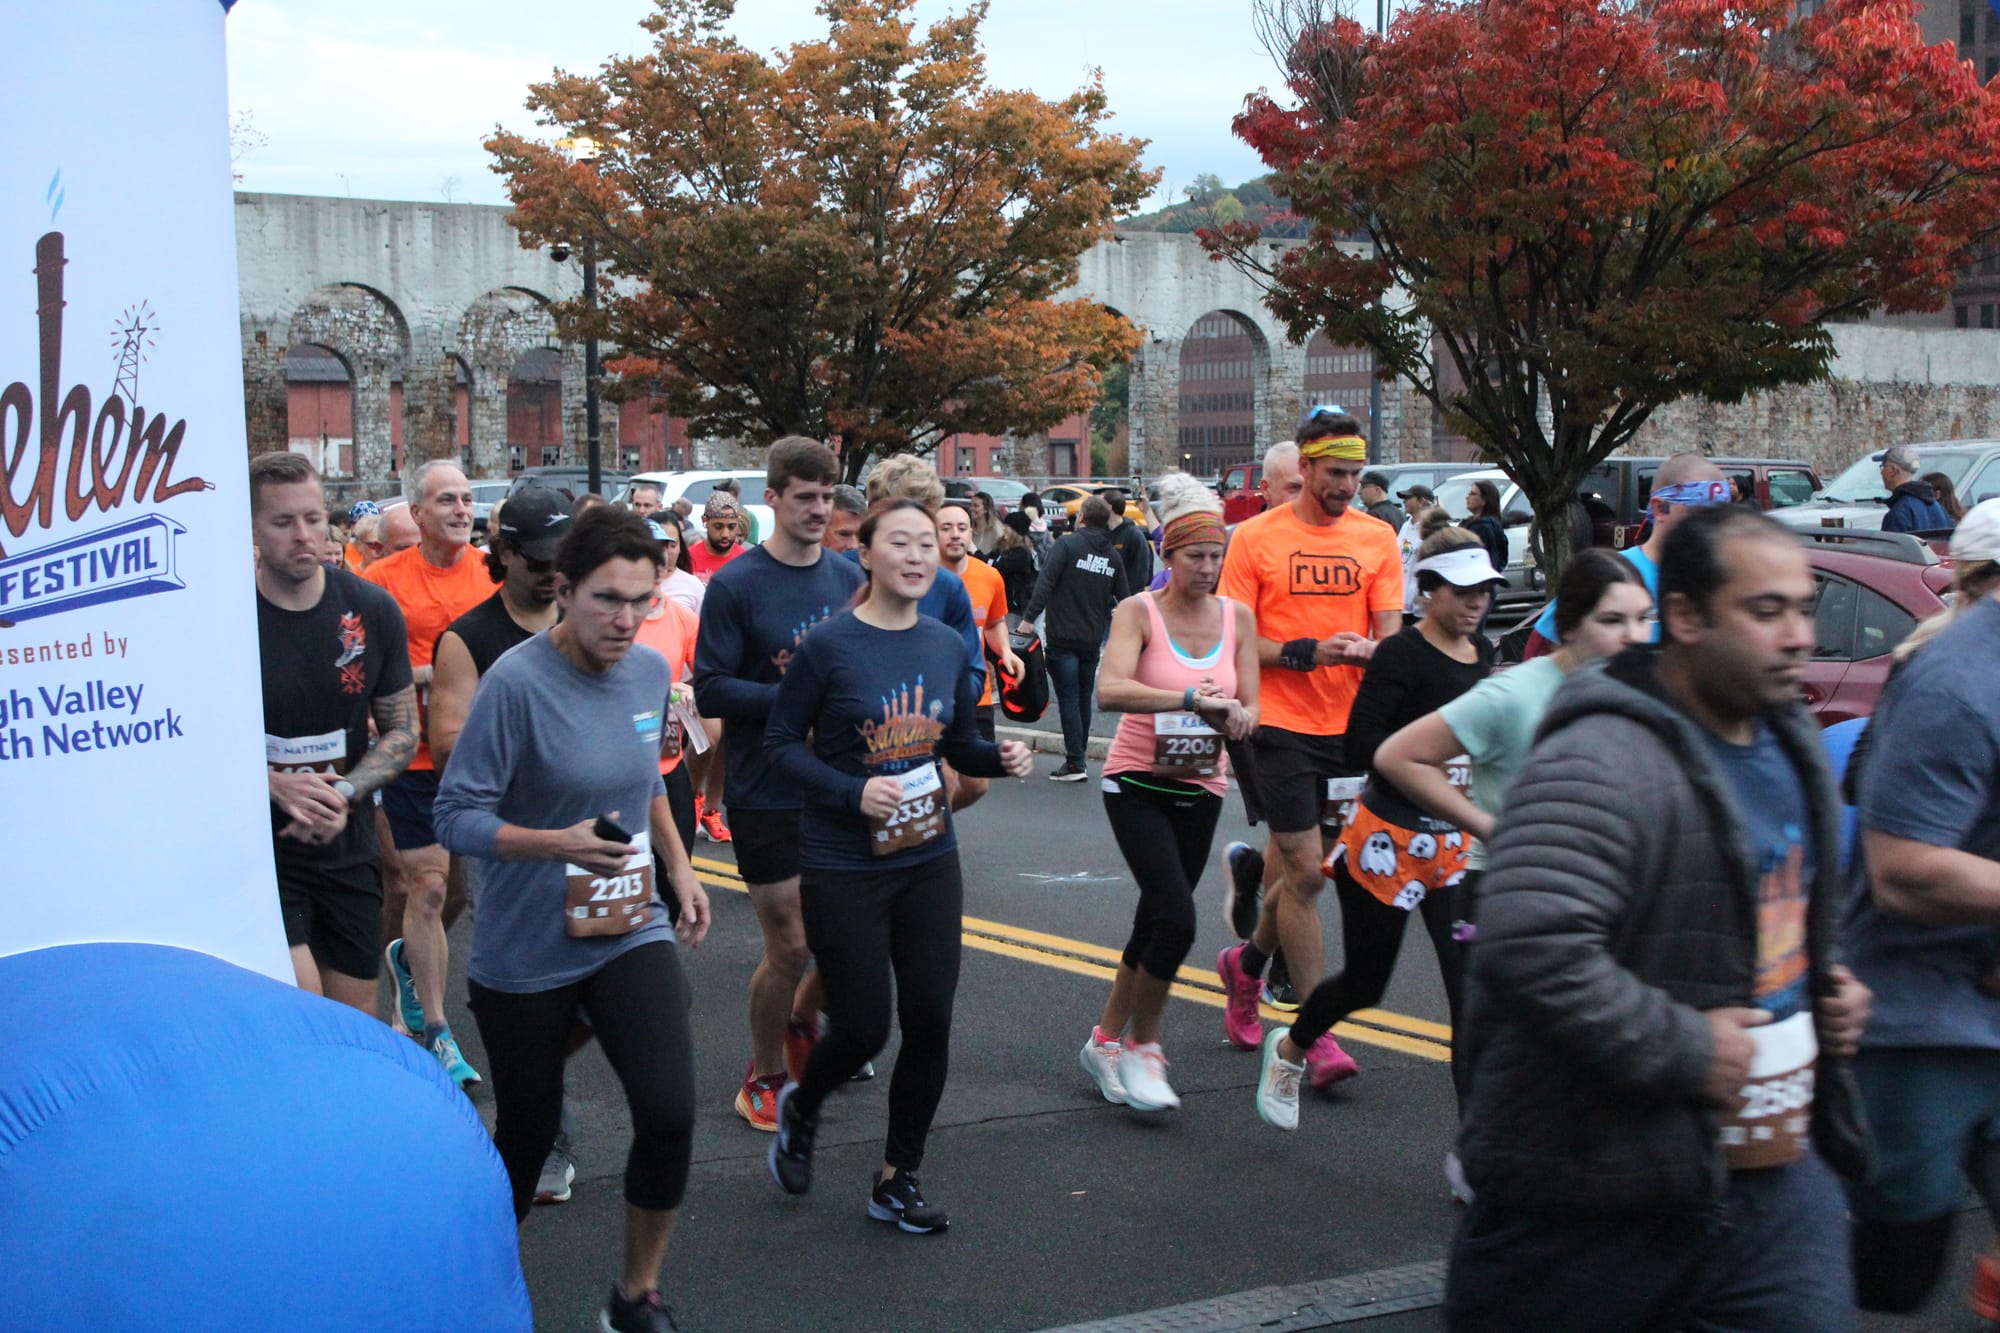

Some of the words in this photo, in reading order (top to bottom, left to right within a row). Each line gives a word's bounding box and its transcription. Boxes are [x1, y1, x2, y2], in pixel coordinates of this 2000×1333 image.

[0, 536, 157, 606] FESTIVAL
[1076, 558, 1115, 577] DIRECTOR
[1296, 565, 1351, 585] run
[104, 631, 128, 658] by
[38, 680, 144, 716] Valley
[42, 708, 184, 757] Network
[1166, 738, 1215, 754] 2206
[589, 872, 643, 902] 2213
